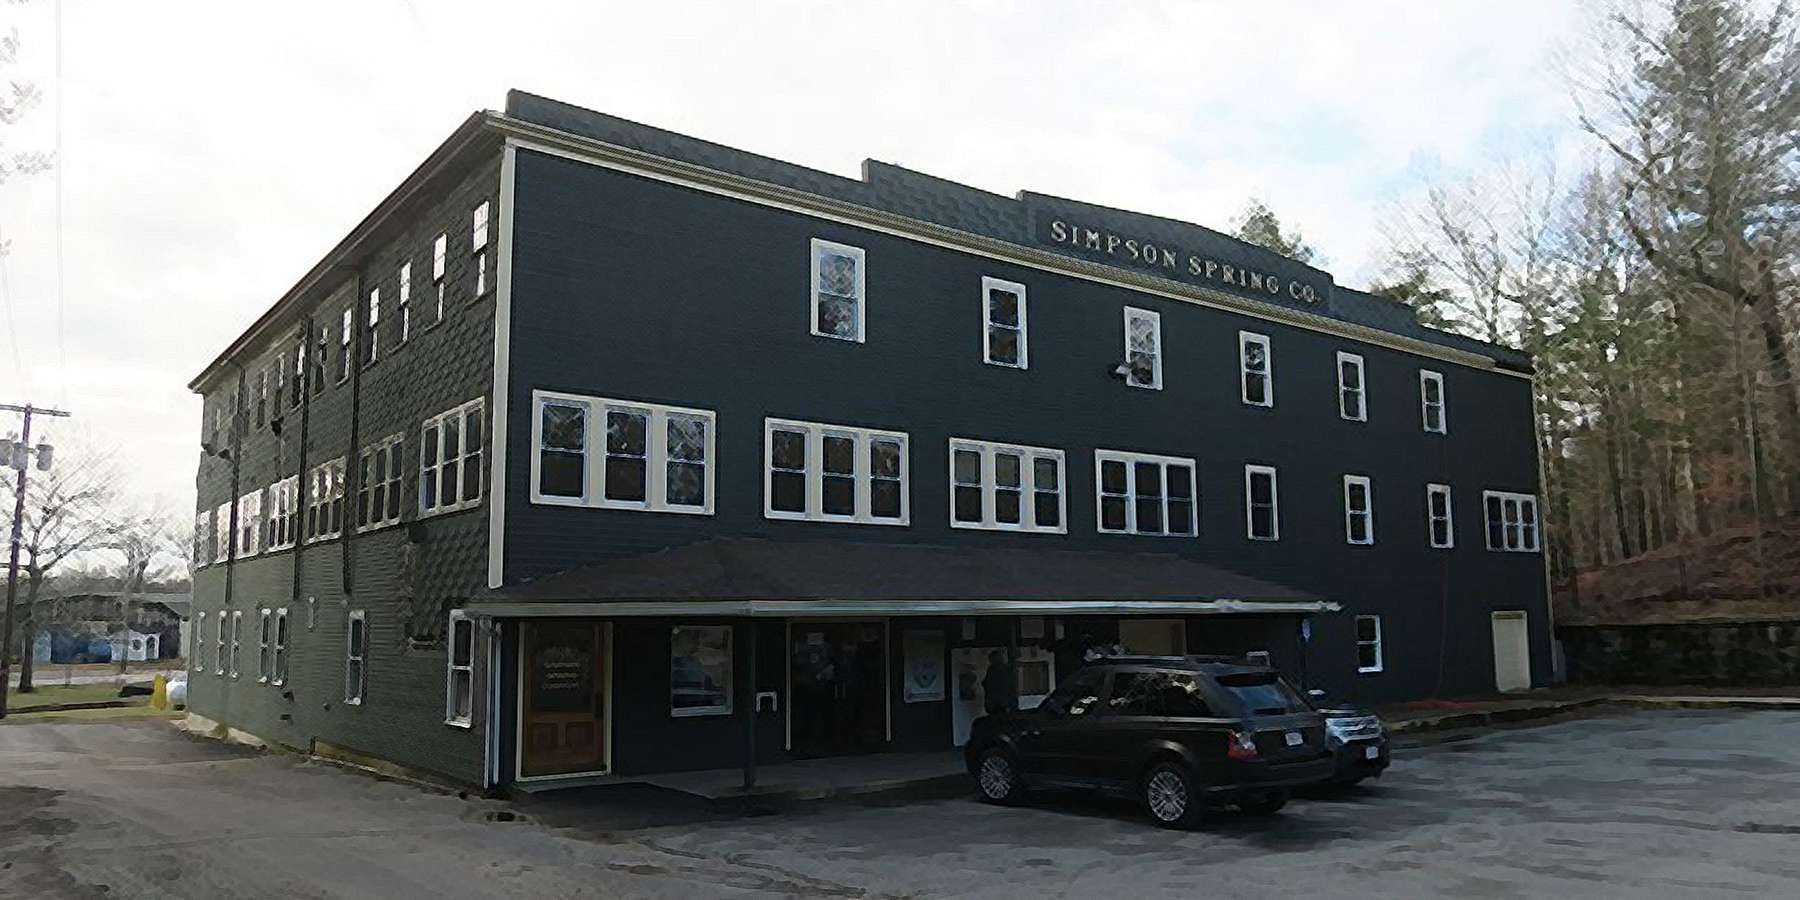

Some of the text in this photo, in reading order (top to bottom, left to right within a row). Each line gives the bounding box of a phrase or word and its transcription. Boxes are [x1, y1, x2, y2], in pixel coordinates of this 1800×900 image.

[1050, 220, 1321, 303] SIMPSON SPRING CO.
